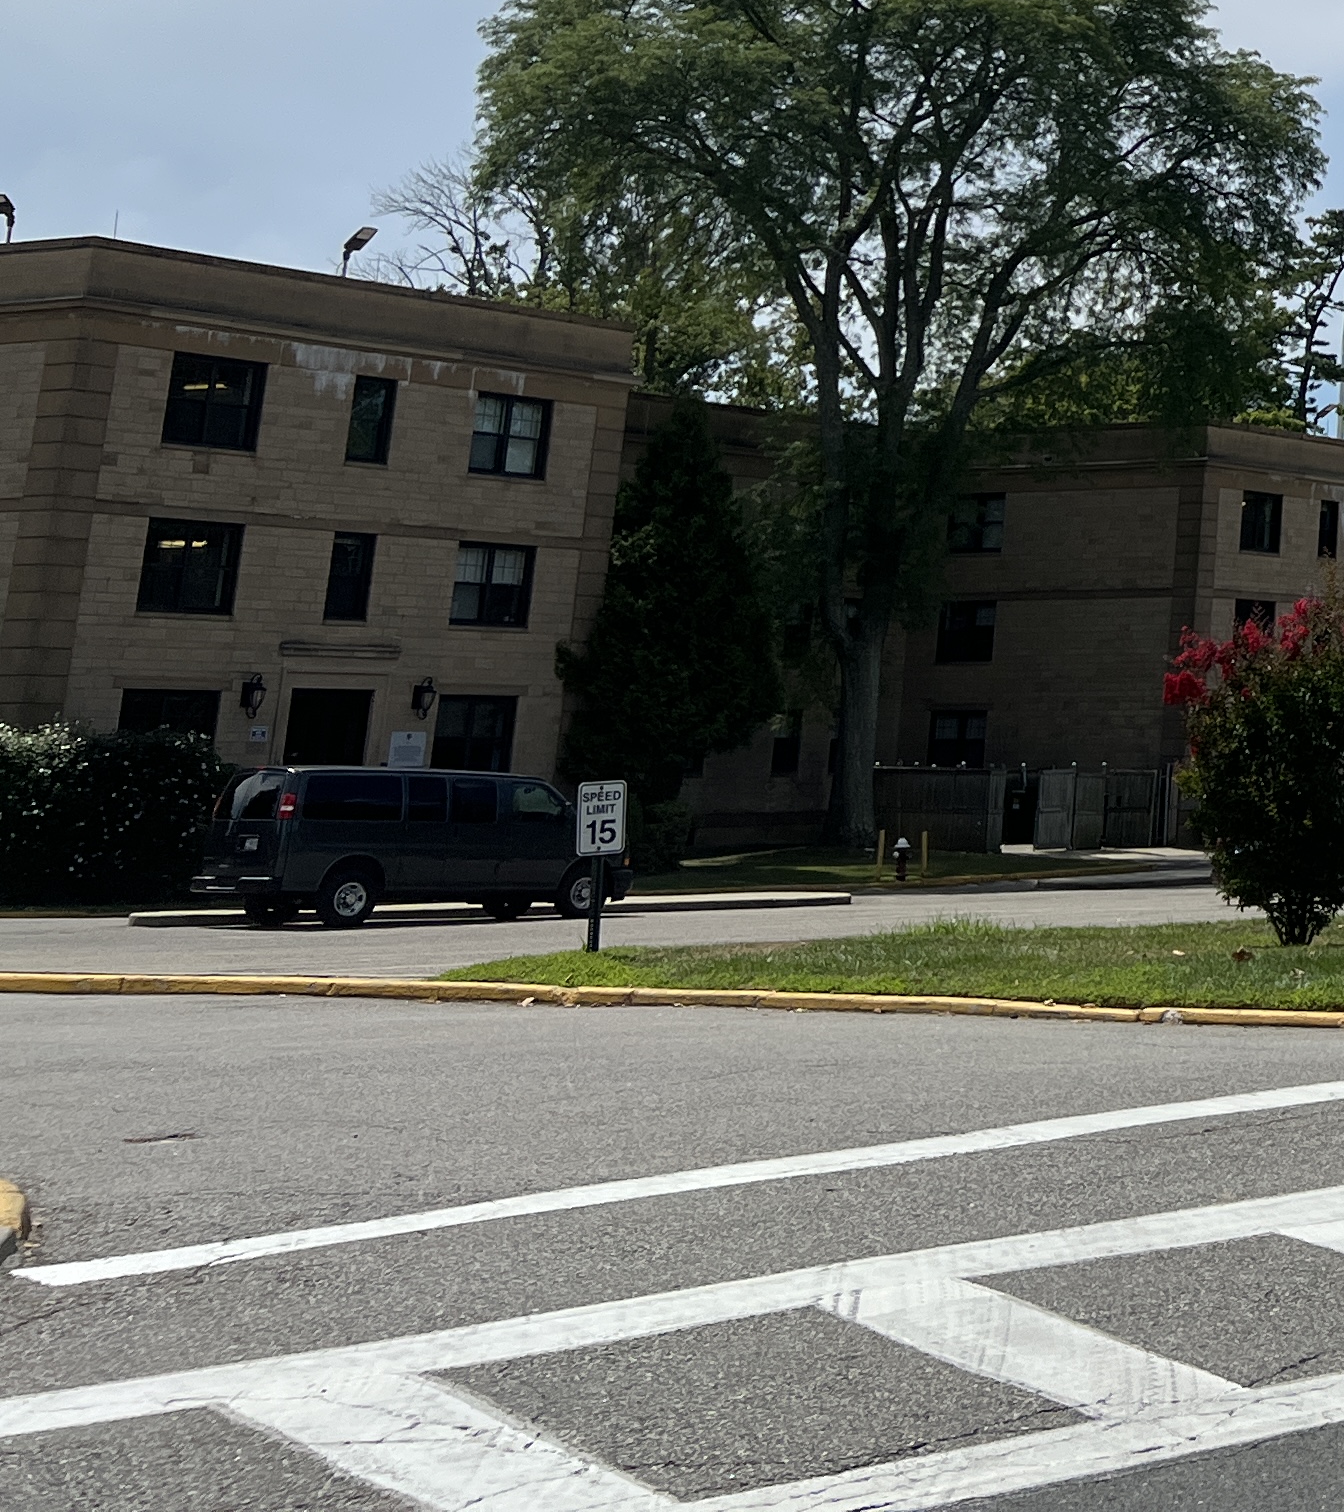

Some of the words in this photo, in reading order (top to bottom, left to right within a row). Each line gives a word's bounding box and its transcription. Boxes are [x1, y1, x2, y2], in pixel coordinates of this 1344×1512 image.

[583, 791, 621, 802] SPEED
[587, 804, 616, 815] LIMIT
[586, 819, 616, 844] 15
